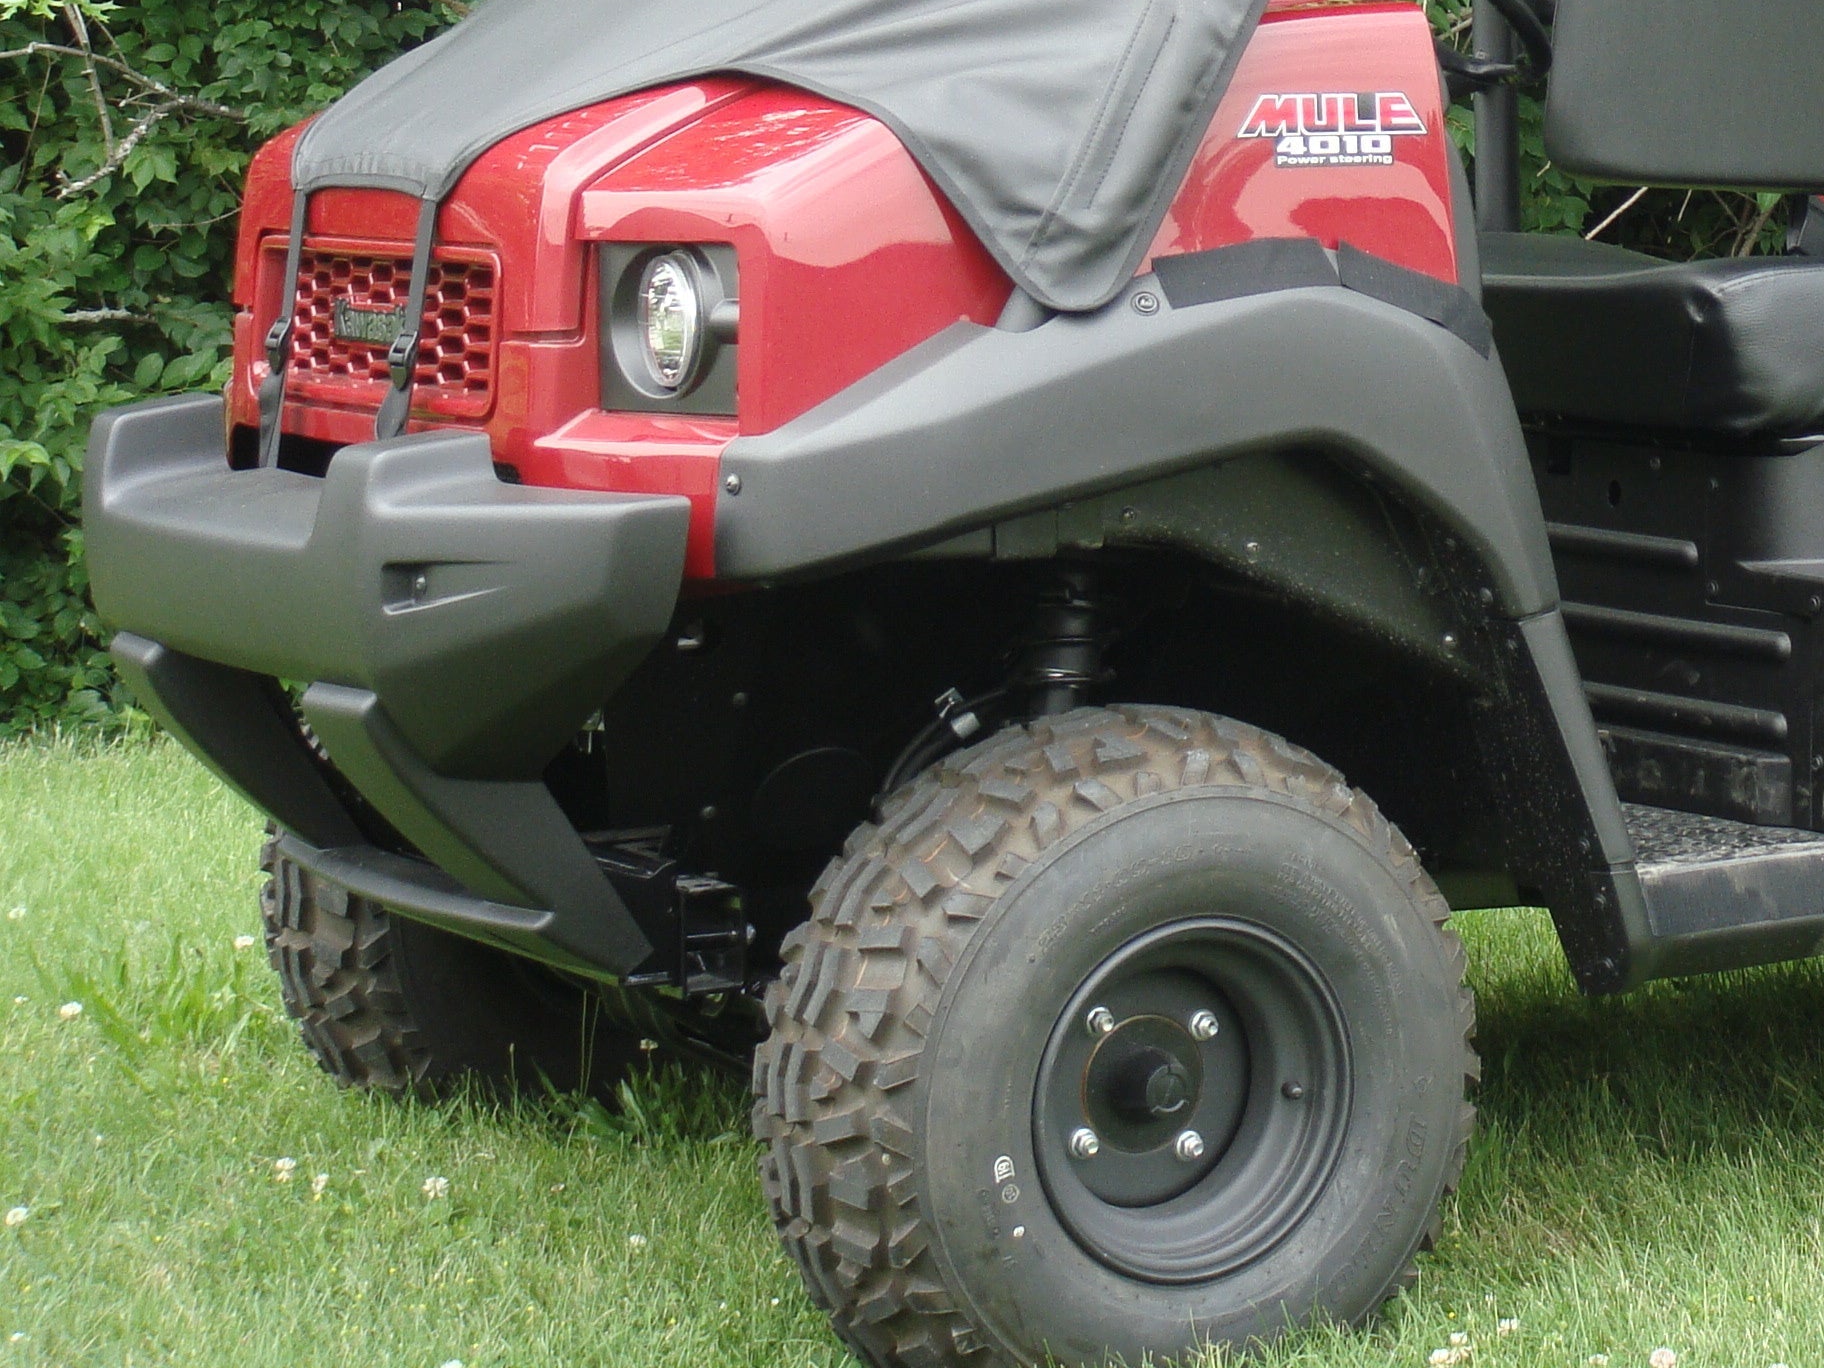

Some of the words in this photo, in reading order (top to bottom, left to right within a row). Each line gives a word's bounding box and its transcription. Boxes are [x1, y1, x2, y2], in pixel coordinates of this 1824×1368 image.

[1237, 92, 1428, 138] MULE
[1277, 135, 1392, 155] 4010
[1277, 156, 1327, 166] Power
